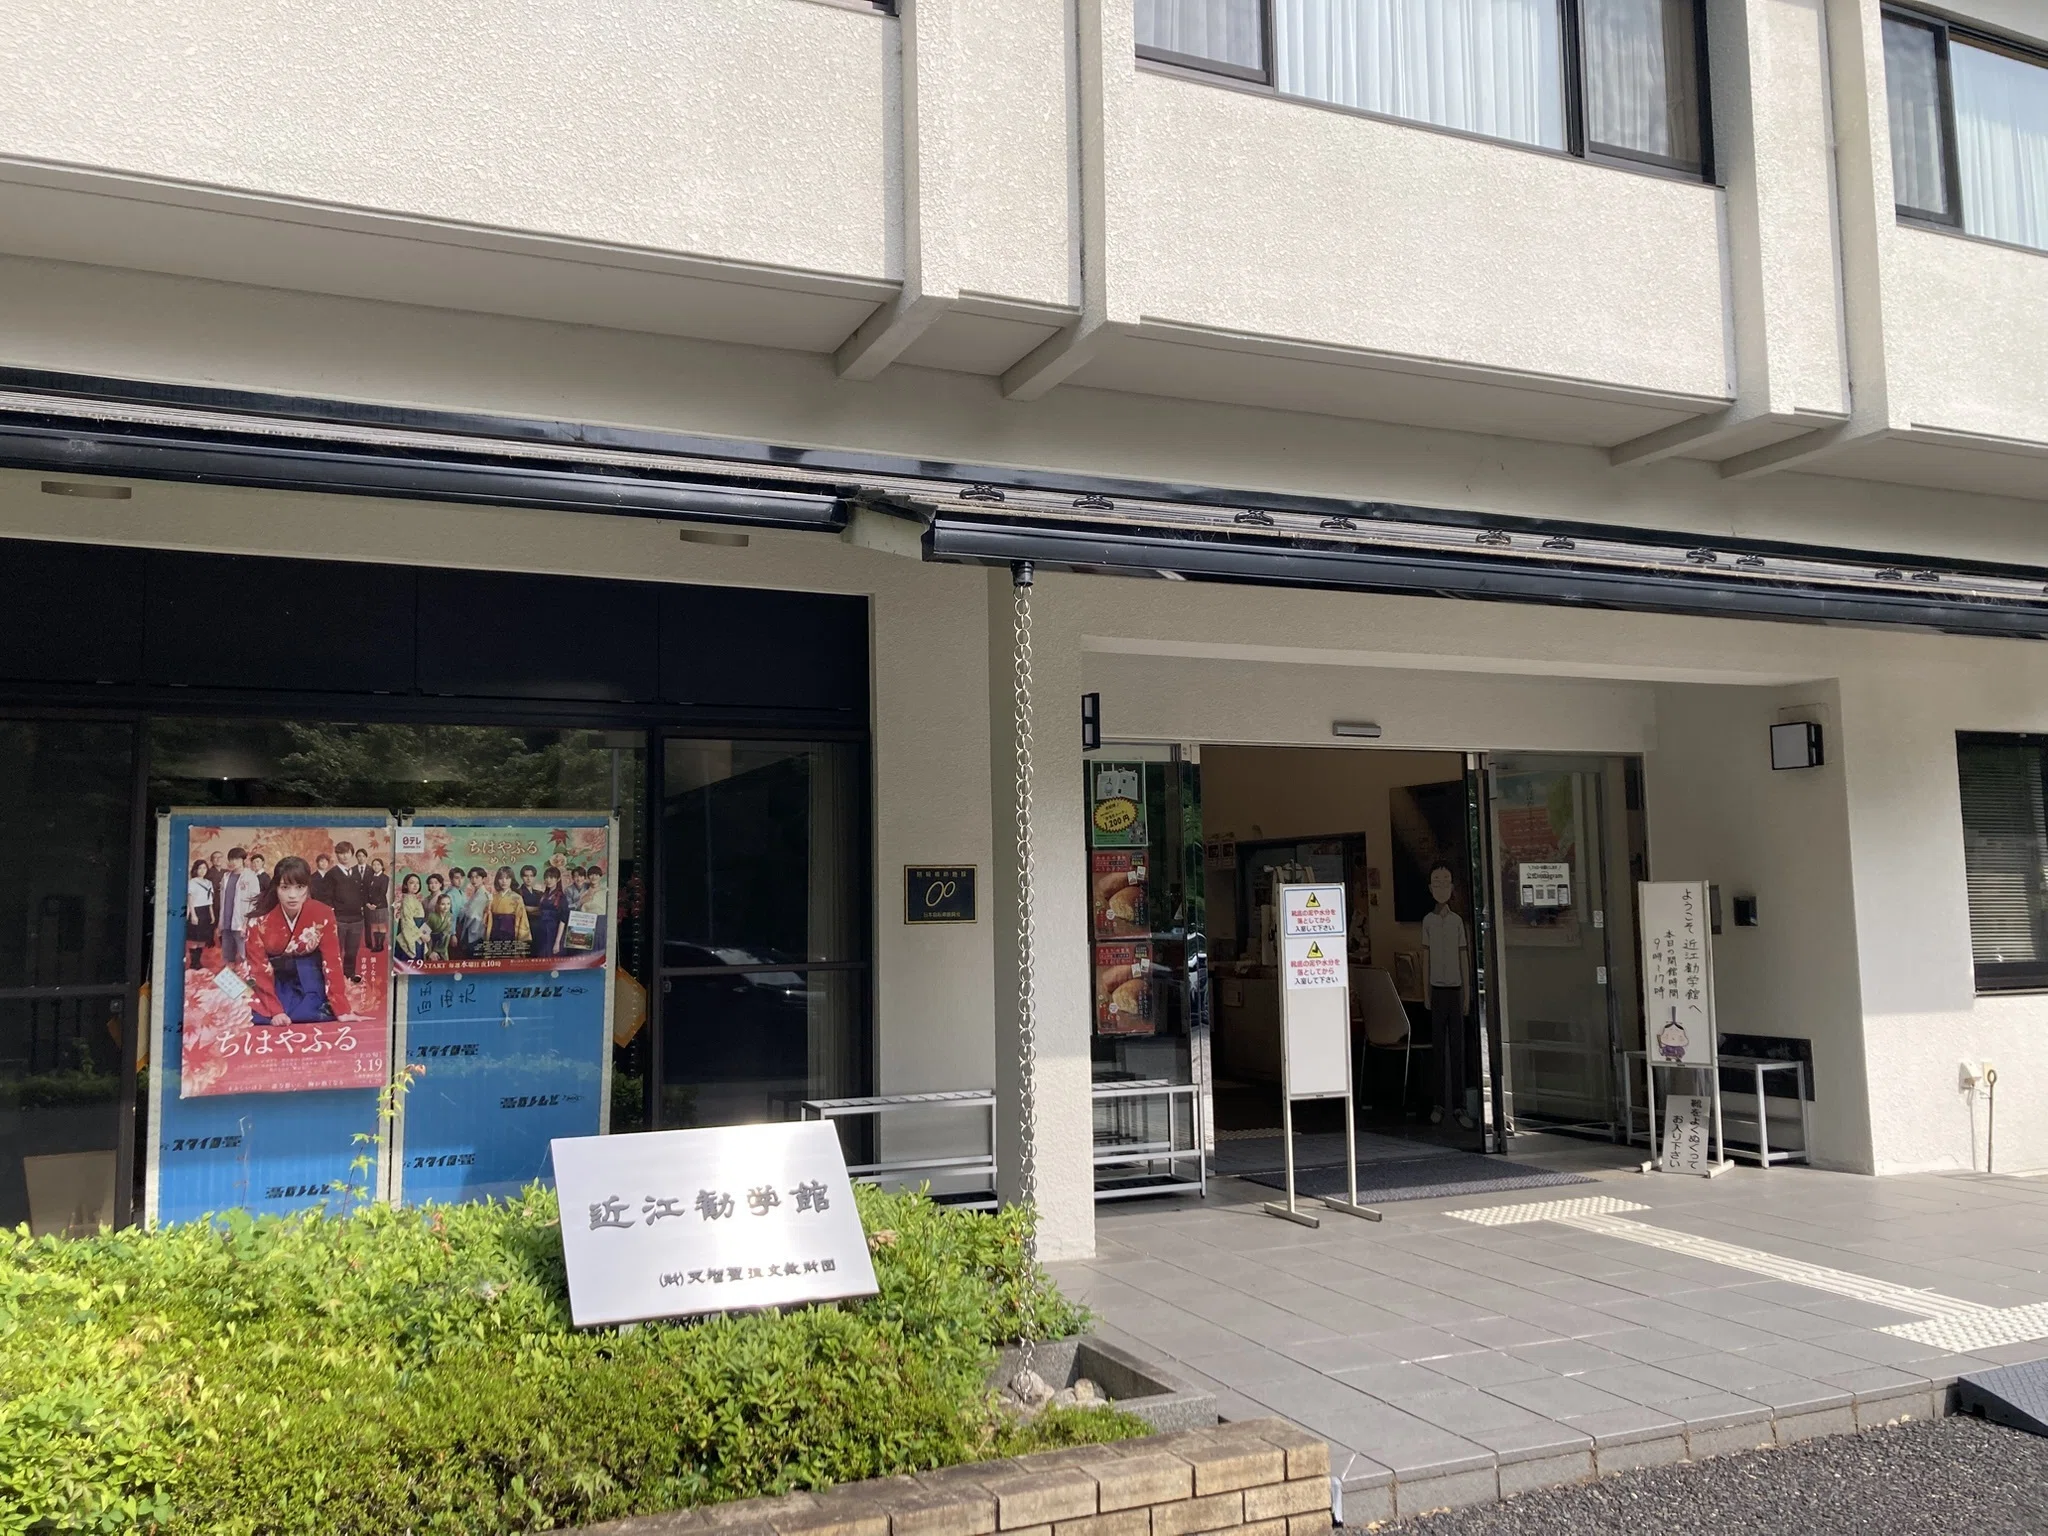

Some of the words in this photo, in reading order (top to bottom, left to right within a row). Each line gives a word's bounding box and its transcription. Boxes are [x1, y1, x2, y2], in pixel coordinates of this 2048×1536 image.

[402, 836, 422, 845] 日テレ
[468, 839, 539, 855] ちはやふる
[489, 856, 517, 865] めぐり
[1291, 909, 1337, 917] 靴底の泥や水分を
[1297, 917, 1332, 925] 落としてから
[1290, 959, 1340, 968] 靴底の泥や水分を
[1664, 929, 1679, 1000] 本日の開館時間
[1297, 968, 1334, 976] 落としてから
[1294, 976, 1339, 985] 入室して下さい
[216, 1026, 357, 1058] ちはやふる
[353, 1058, 382, 1074] 3.19
[1669, 1115, 1684, 1168] お入り下さい
[588, 1179, 831, 1231] 近江勧学館
